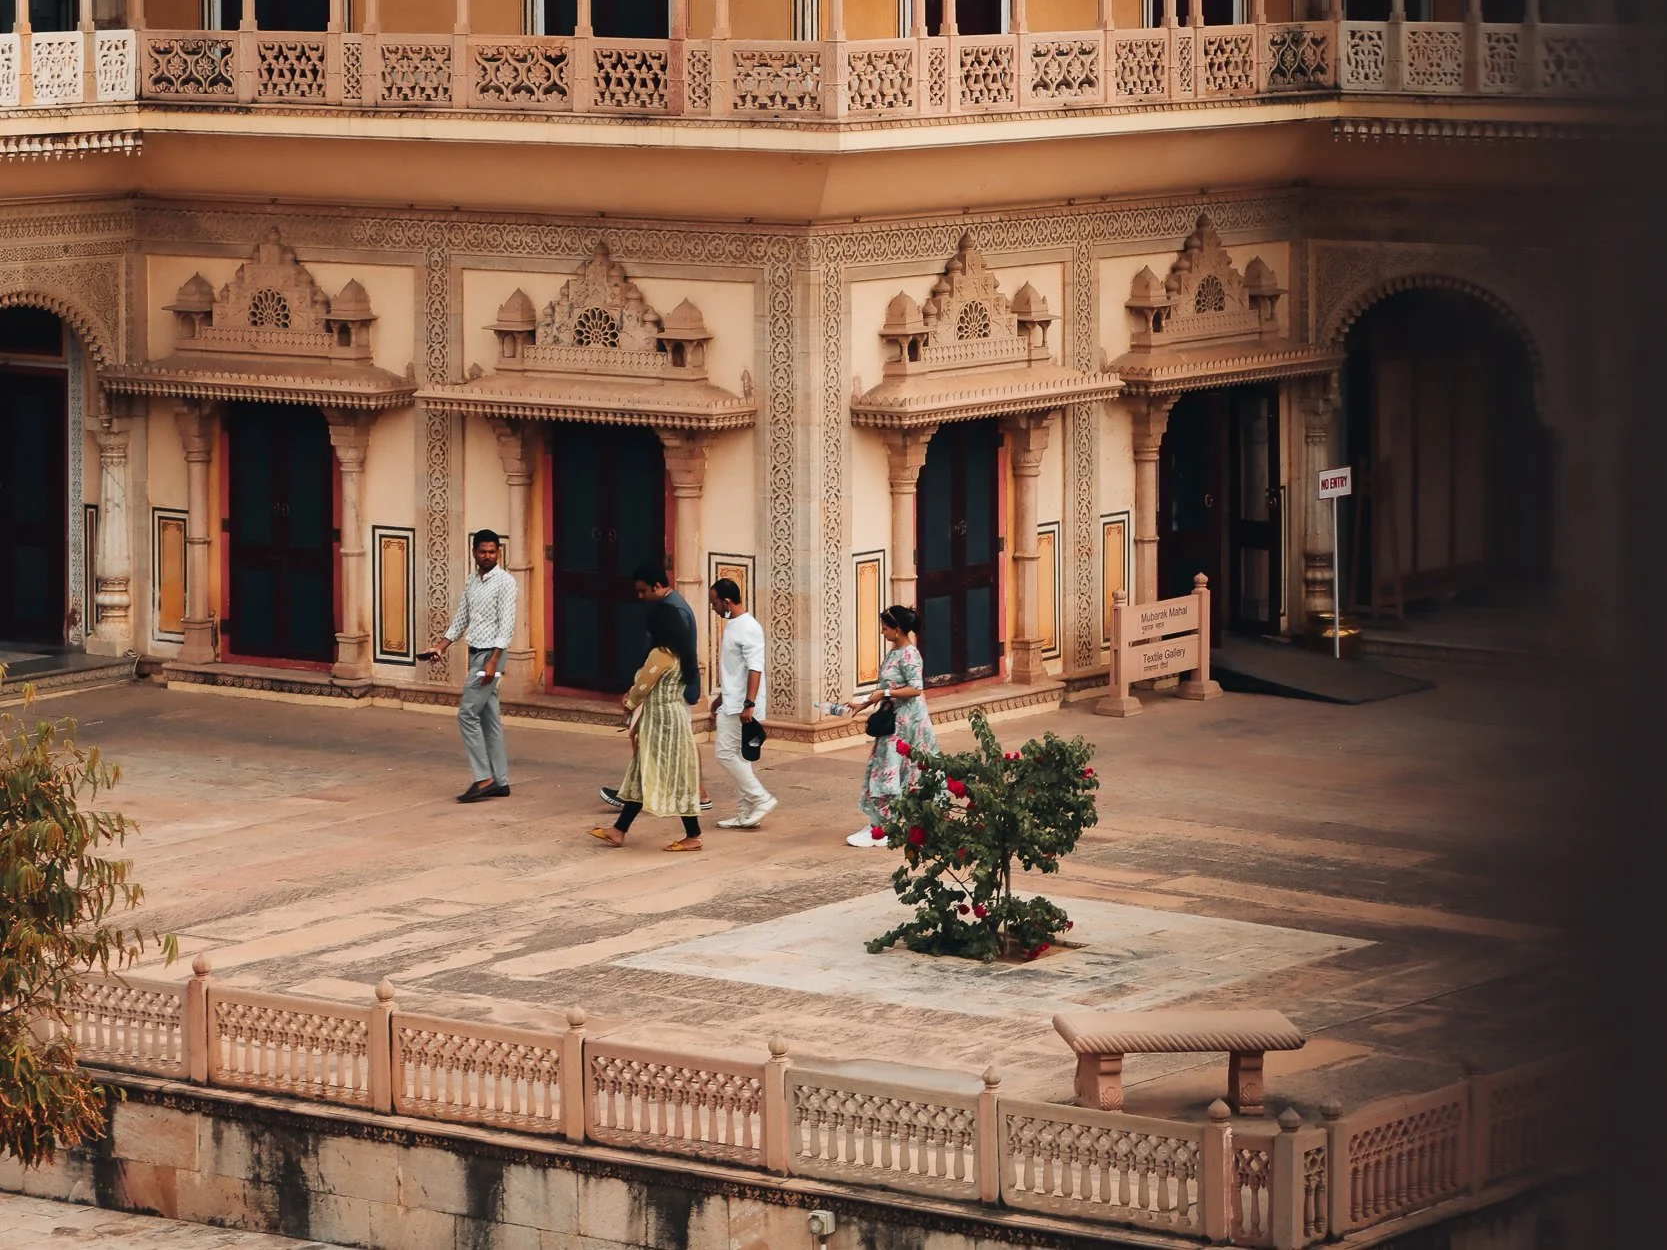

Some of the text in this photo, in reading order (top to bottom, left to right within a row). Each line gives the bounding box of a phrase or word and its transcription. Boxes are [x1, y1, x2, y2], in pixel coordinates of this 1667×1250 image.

[1320, 475, 1348, 490] NO ENTRY
[1141, 605, 1188, 623] Mubarak Mahal
[1142, 648, 1186, 663] Textile Gallery
